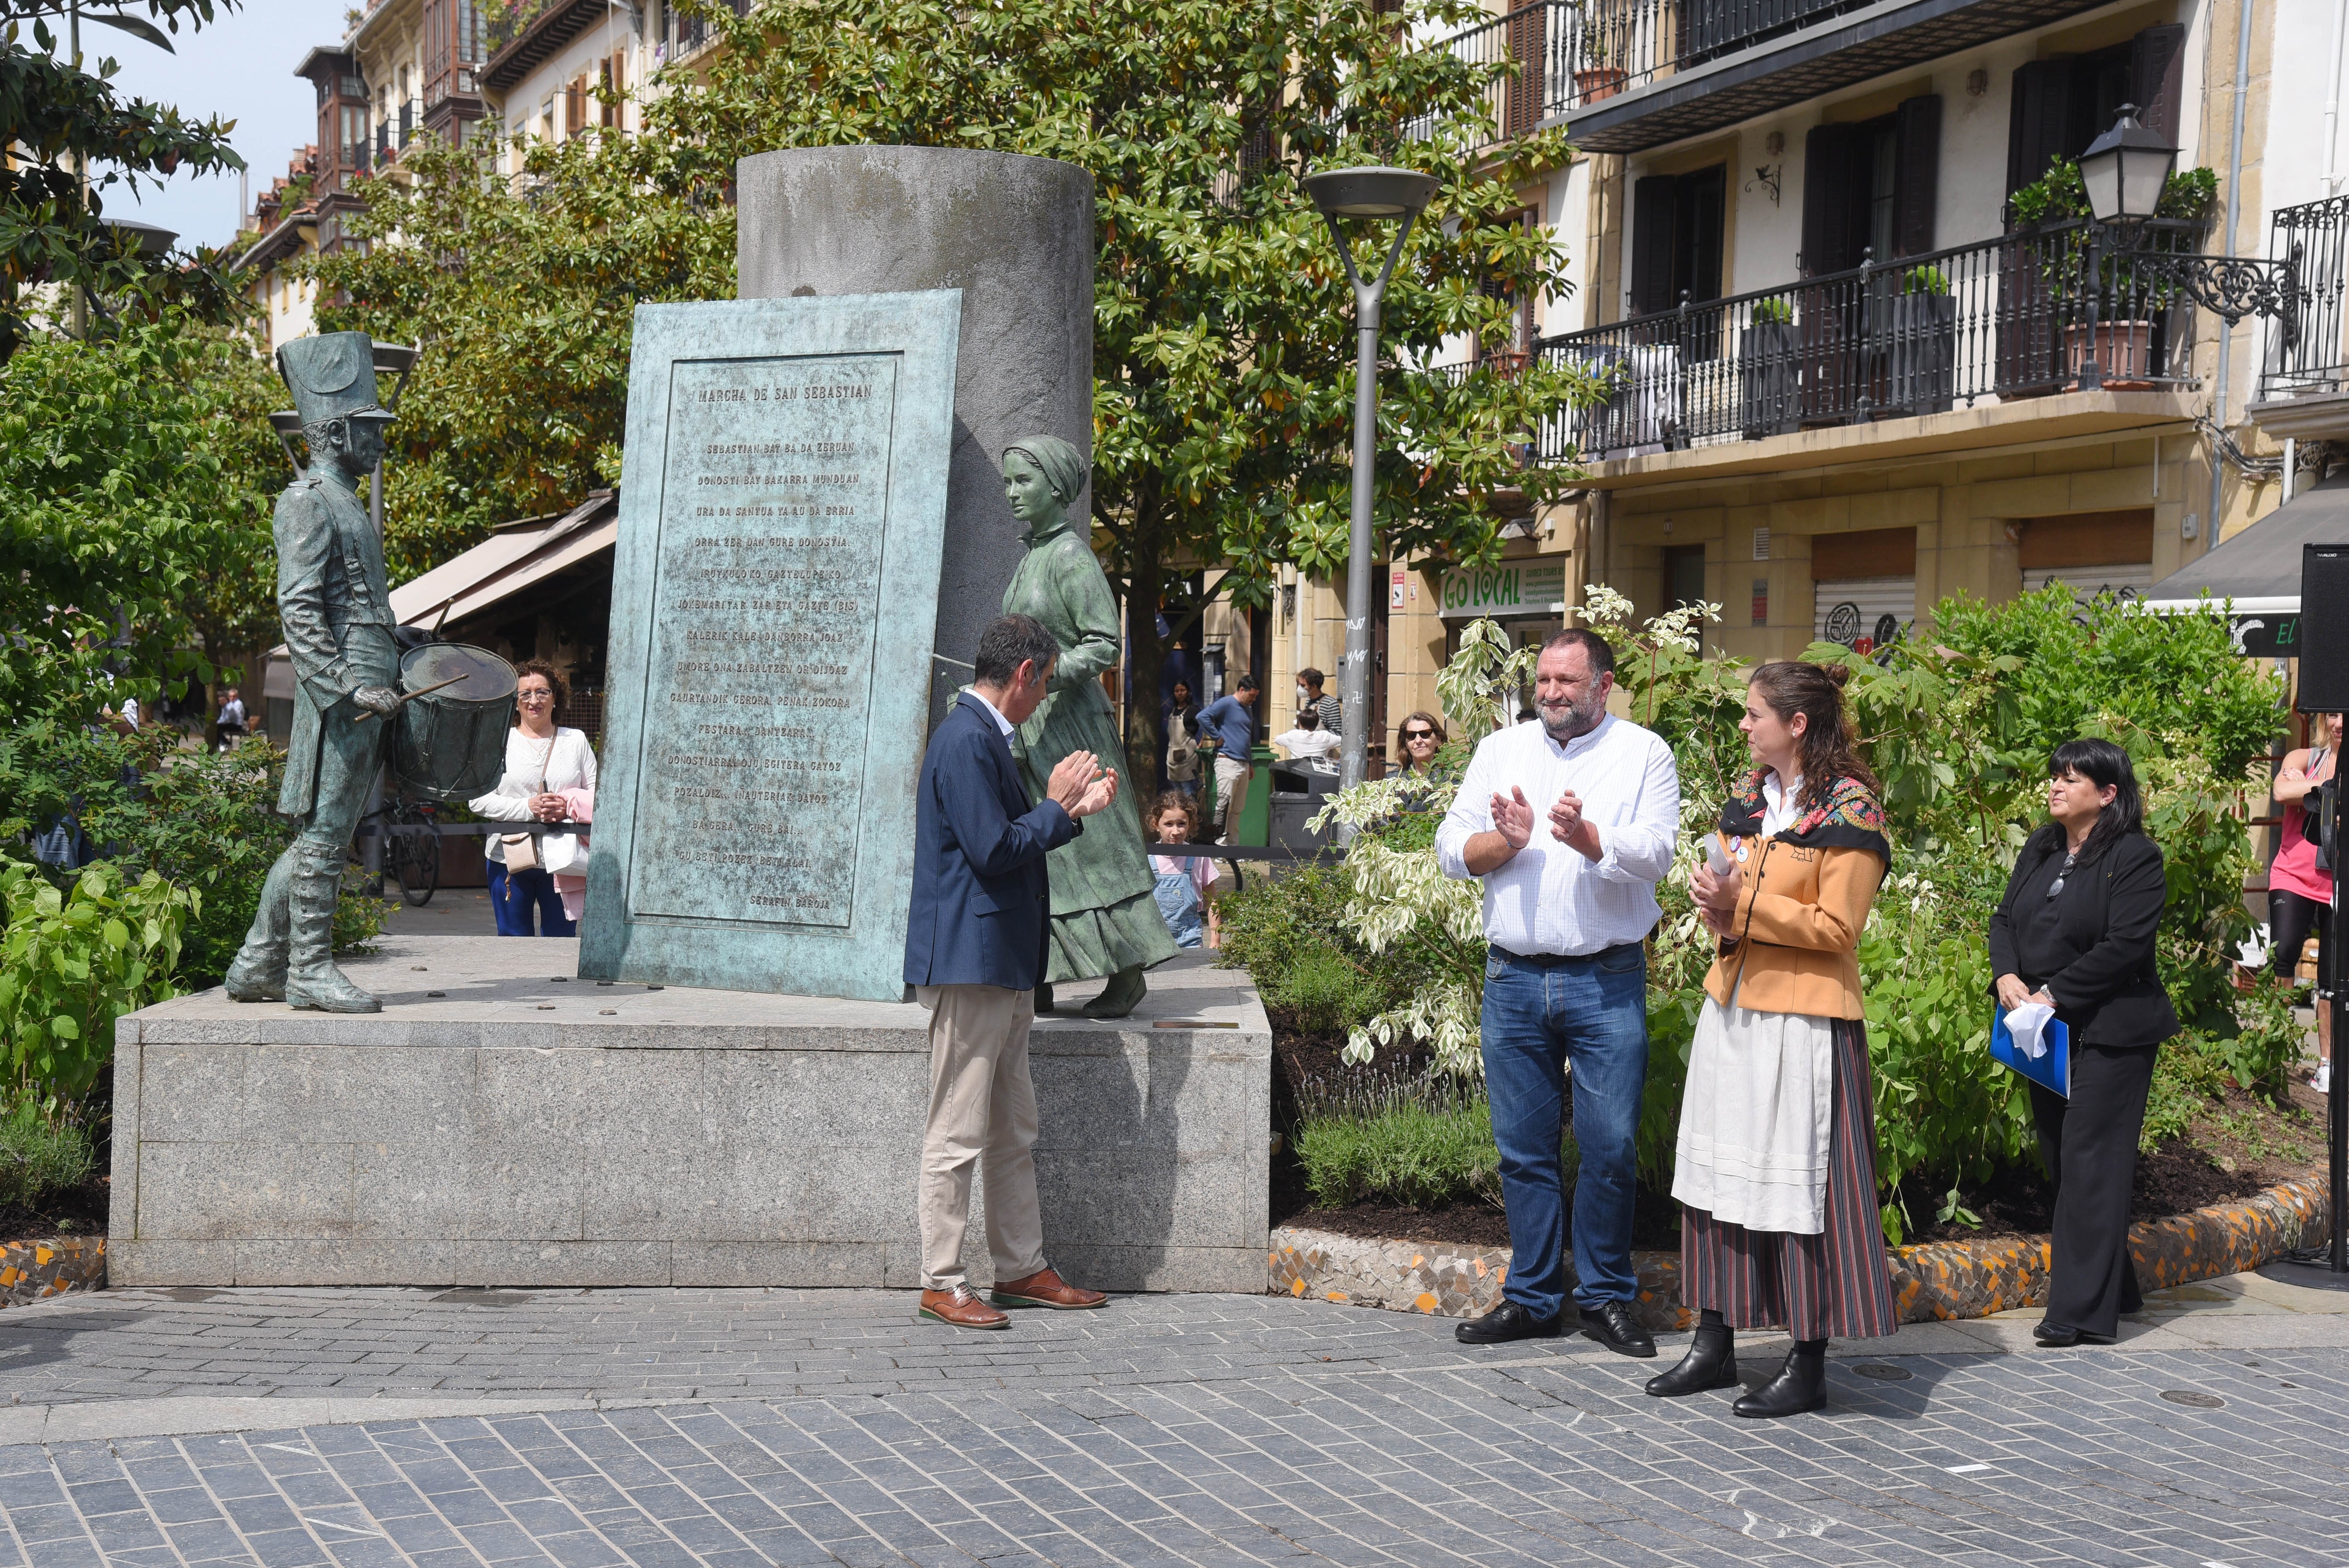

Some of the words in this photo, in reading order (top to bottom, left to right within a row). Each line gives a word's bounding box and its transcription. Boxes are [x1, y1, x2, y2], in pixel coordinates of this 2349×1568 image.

[698, 389, 746, 402] MARCHA
[754, 388, 768, 401] DE
[775, 387, 797, 400] SAN
[804, 384, 872, 399] SEBASTIAN
[707, 444, 760, 454] SEBASTIAN
[763, 443, 781, 453] BAT
[784, 443, 796, 453] BA
[800, 443, 812, 452] DA
[817, 442, 855, 452] ZERUAN
[698, 475, 739, 485] DONOSTI
[743, 475, 761, 485] BAT
[764, 475, 808, 484] BAKARRA
[812, 473, 859, 483] MUNDUAN
[697, 506, 714, 516] URA
[719, 506, 731, 516] DA
[735, 506, 773, 516] SANTUA
[778, 506, 788, 516] TA
[792, 506, 805, 516] AU
[809, 506, 821, 516] DA
[826, 505, 854, 515] ERRIA
[695, 537, 719, 547] ORRA
[724, 537, 742, 547] ZER
[747, 537, 765, 547] DAN
[769, 537, 794, 547] GURE
[799, 537, 850, 547] DONOSTIA.
[1444, 573, 1468, 610] GO
[1473, 568, 1520, 607] LOCAL
[752, 600, 771, 609] ZAR
[776, 601, 792, 610] ETA
[799, 601, 829, 610] GAZTE
[834, 599, 858, 612] (BIS)
[687, 631, 728, 640] KALERIK
[765, 632, 815, 642] DANBORRA
[820, 632, 843, 642] JOAZ
[2275, 618, 2297, 645] El
[677, 662, 710, 671] UMORE
[714, 663, 732, 672] ONA
[737, 663, 792, 674] ZABALTZEN
[797, 665, 809, 674] OR
[813, 665, 848, 675] DIJOAZ
[670, 693, 728, 704] GAURTANDIK
[777, 696, 808, 706] PENAK
[813, 697, 850, 708] ZOKORA
[742, 758, 758, 768] OJU
[764, 759, 805, 770] EGITERA
[811, 761, 841, 772] GATOZ
[735, 787, 792, 801] IÑAUTERIAK
[797, 793, 828, 804] DATOZ
[692, 820, 705, 829] BA
[748, 823, 773, 833] GURE
[679, 851, 691, 860] GU
[696, 852, 718, 862] BETI
[760, 856, 784, 867] BETI
[750, 895, 791, 907] SERAFIN
[796, 898, 830, 909] BAROJA
